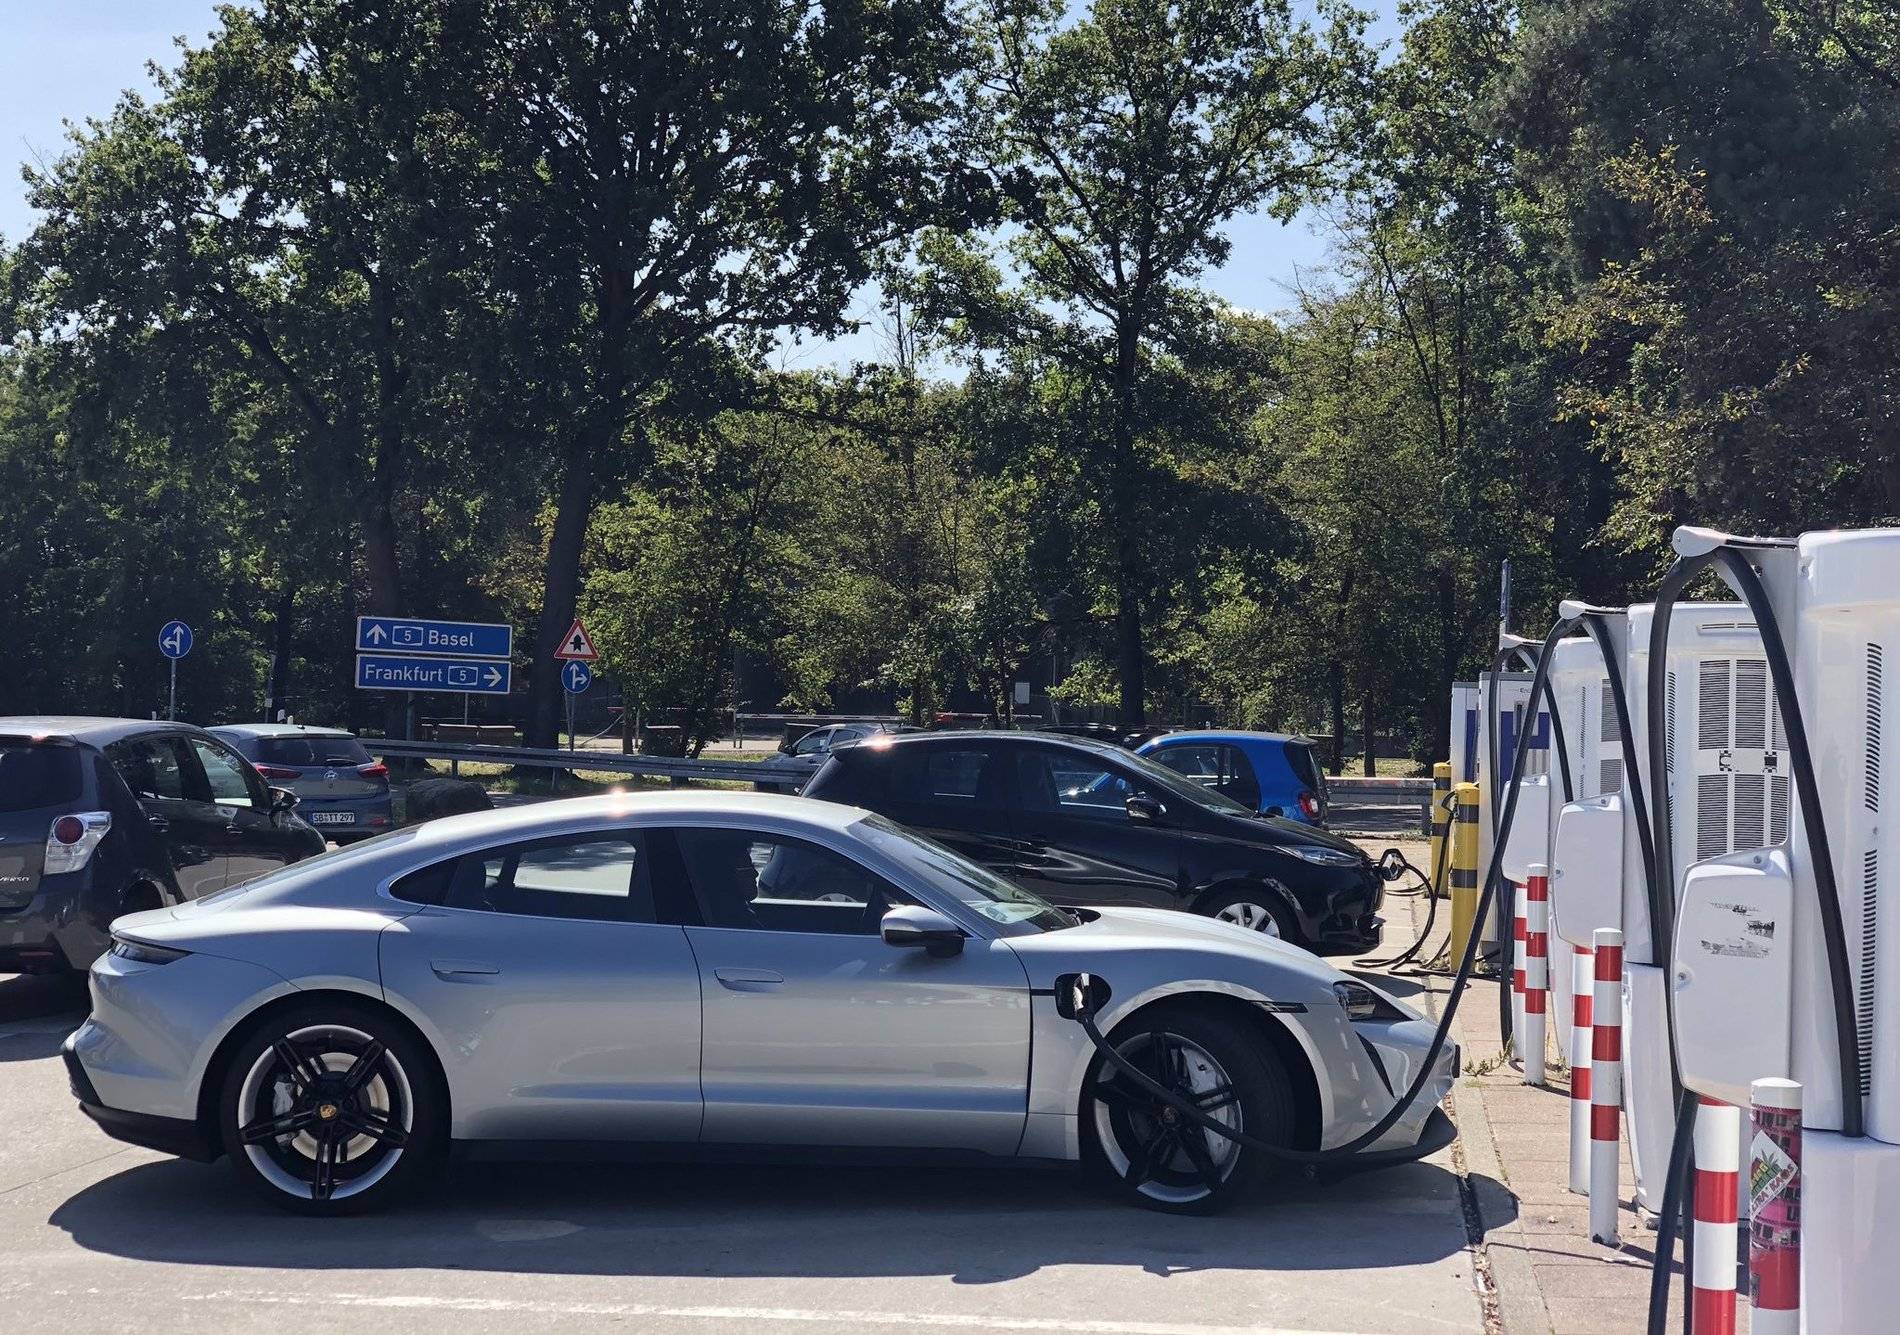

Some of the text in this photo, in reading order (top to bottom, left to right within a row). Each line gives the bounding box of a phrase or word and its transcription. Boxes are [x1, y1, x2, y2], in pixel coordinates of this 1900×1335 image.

[404, 629, 474, 647] 5 Basel
[365, 663, 467, 682] Frankfurt 5
